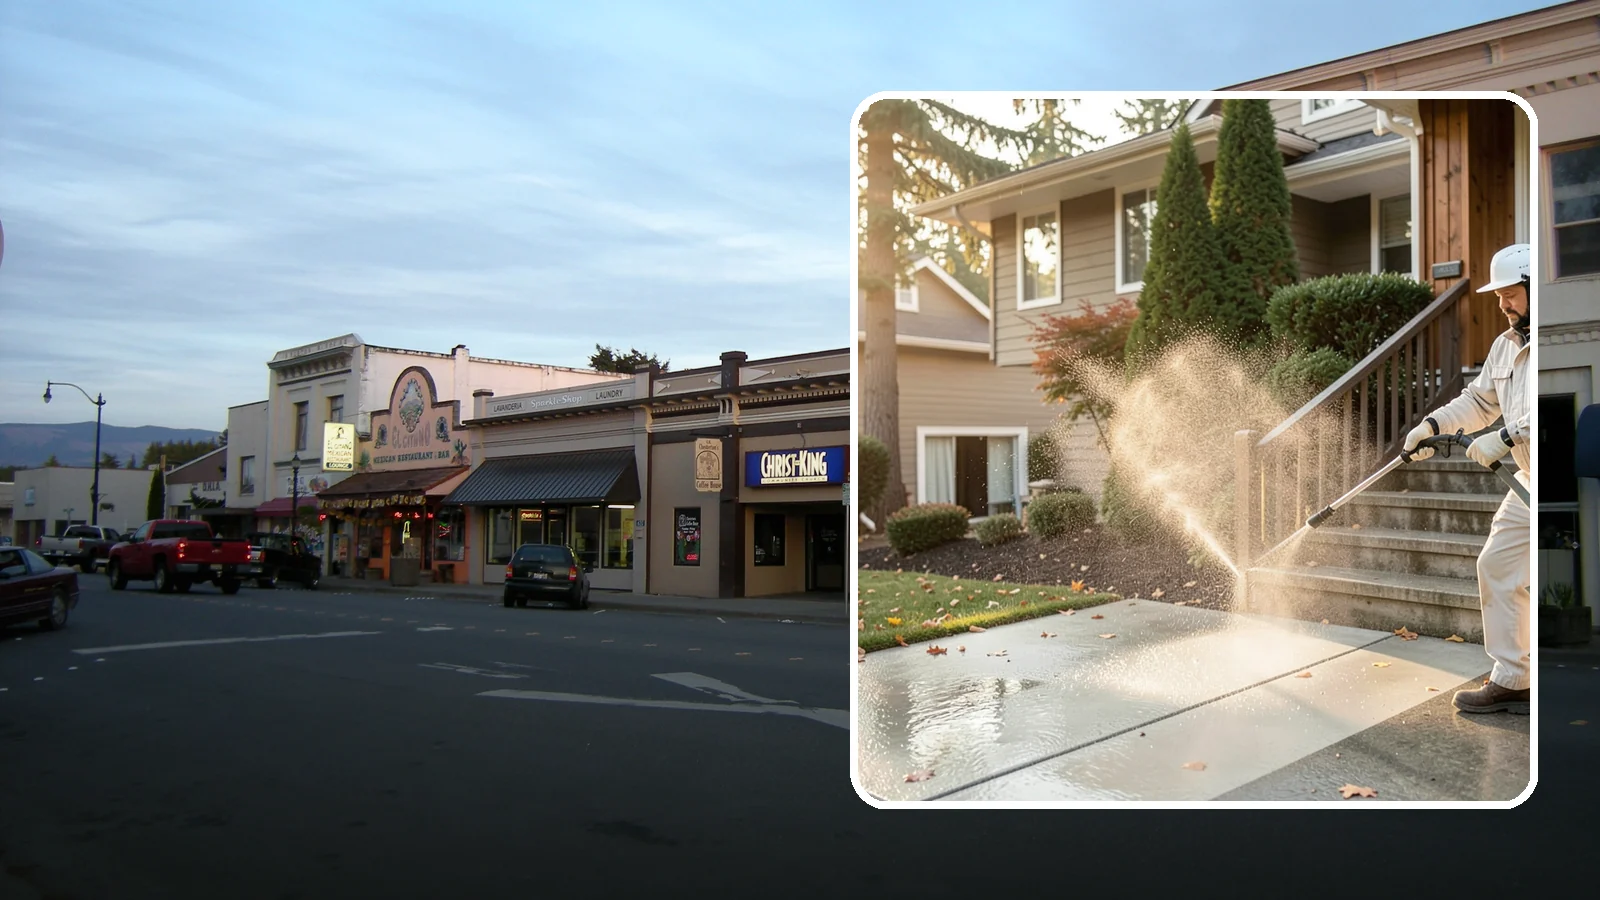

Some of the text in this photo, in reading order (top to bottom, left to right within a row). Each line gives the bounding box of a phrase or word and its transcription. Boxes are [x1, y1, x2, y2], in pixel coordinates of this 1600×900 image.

[561, 394, 583, 406] Shop
[595, 389, 624, 400] LAUNDRY
[493, 402, 523, 413] LAVANDERIA
[392, 426, 402, 449] EL
[374, 455, 396, 463] MEXICAN
[397, 452, 433, 462] RESTAURANT
[438, 450, 450, 459] BAR
[761, 450, 828, 478] CHRIST KING
